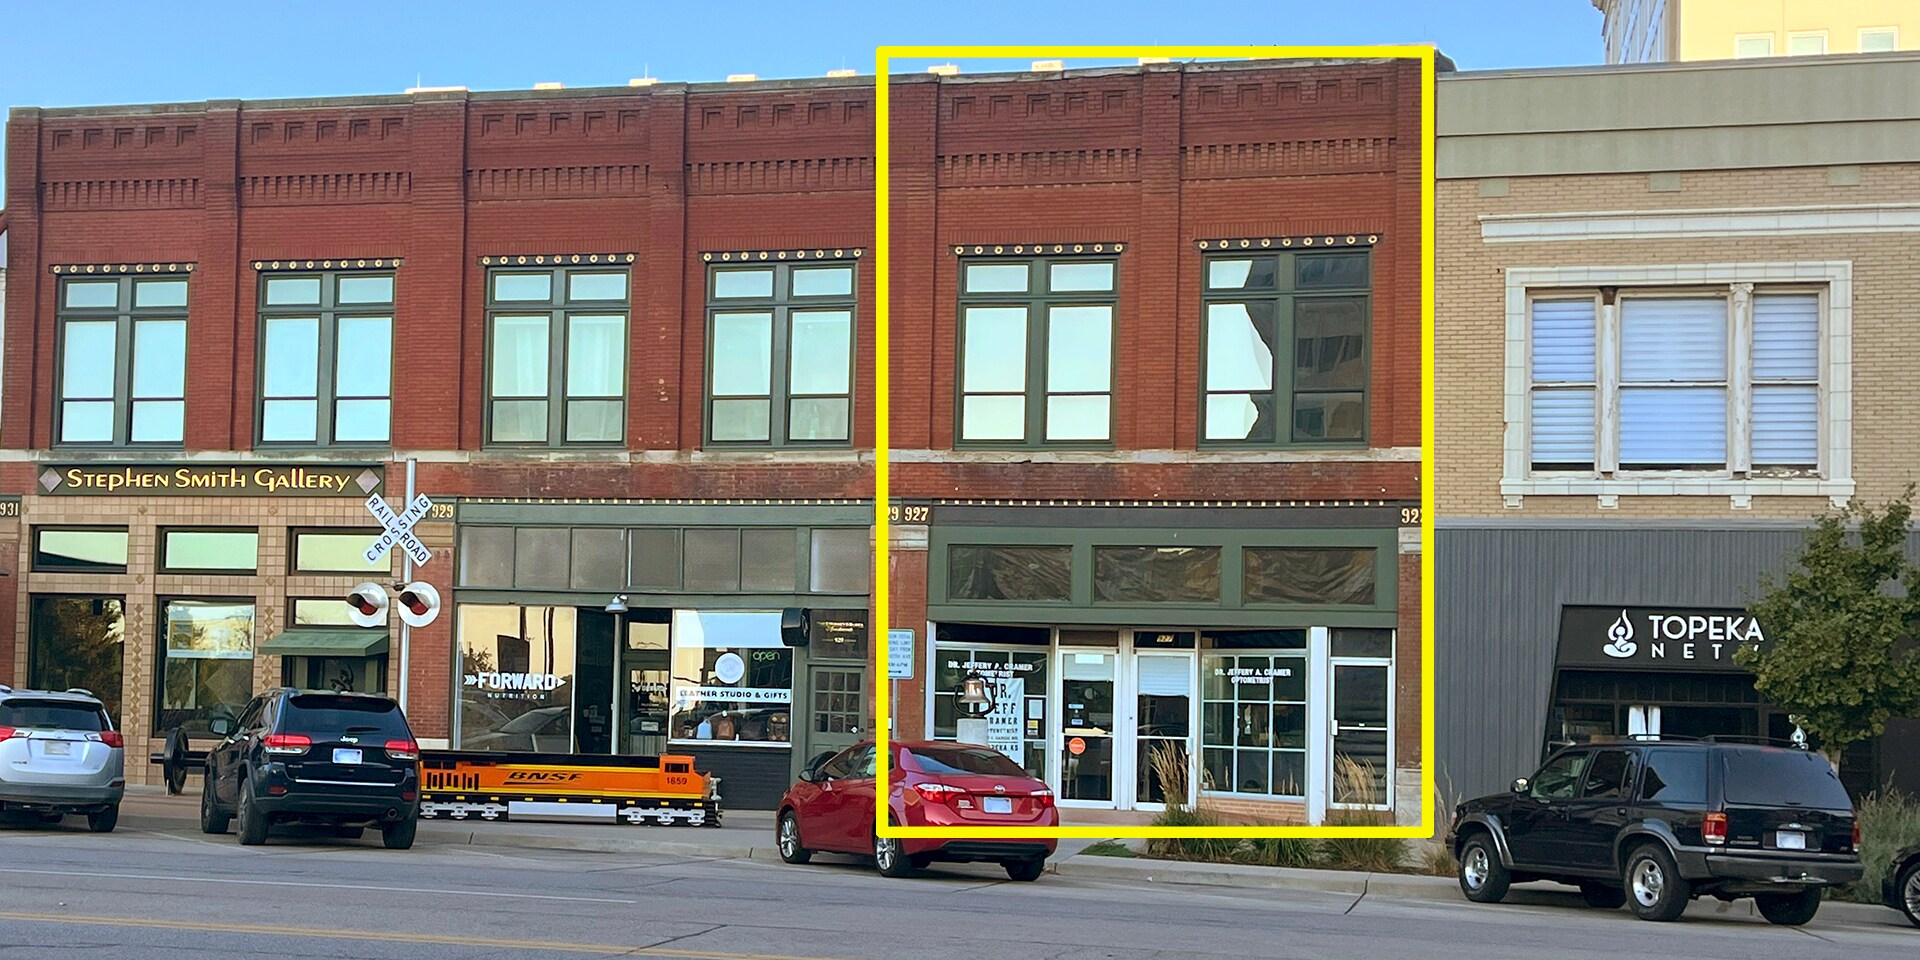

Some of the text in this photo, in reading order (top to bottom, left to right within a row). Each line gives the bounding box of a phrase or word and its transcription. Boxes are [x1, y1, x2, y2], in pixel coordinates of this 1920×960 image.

[67, 467, 351, 493] Stephen Smith Gallery
[0, 502, 19, 516] 931
[432, 504, 454, 518] 929
[904, 506, 929, 522] 927
[1401, 508, 1423, 524] 92
[366, 497, 429, 561] CROSSING
[368, 497, 427, 562] RAILROAD
[1648, 615, 1764, 641] TOPEKA
[752, 651, 781, 662] open
[948, 661, 960, 669] DR.
[962, 661, 992, 669] JEFFERY
[1004, 663, 1034, 672] CRAMER
[1227, 668, 1254, 676] JEFFERY
[1255, 668, 1262, 676] A.
[1264, 668, 1291, 677] CRAMER
[477, 672, 556, 691] FORWARD
[1231, 676, 1274, 684] OPTOMETRIST
[487, 692, 545, 700] NUTRITION
[720, 690, 752, 698] STUDIO
[764, 691, 788, 699] GIFTS
[994, 702, 1016, 714] EFF
[508, 772, 583, 781] BNSF
